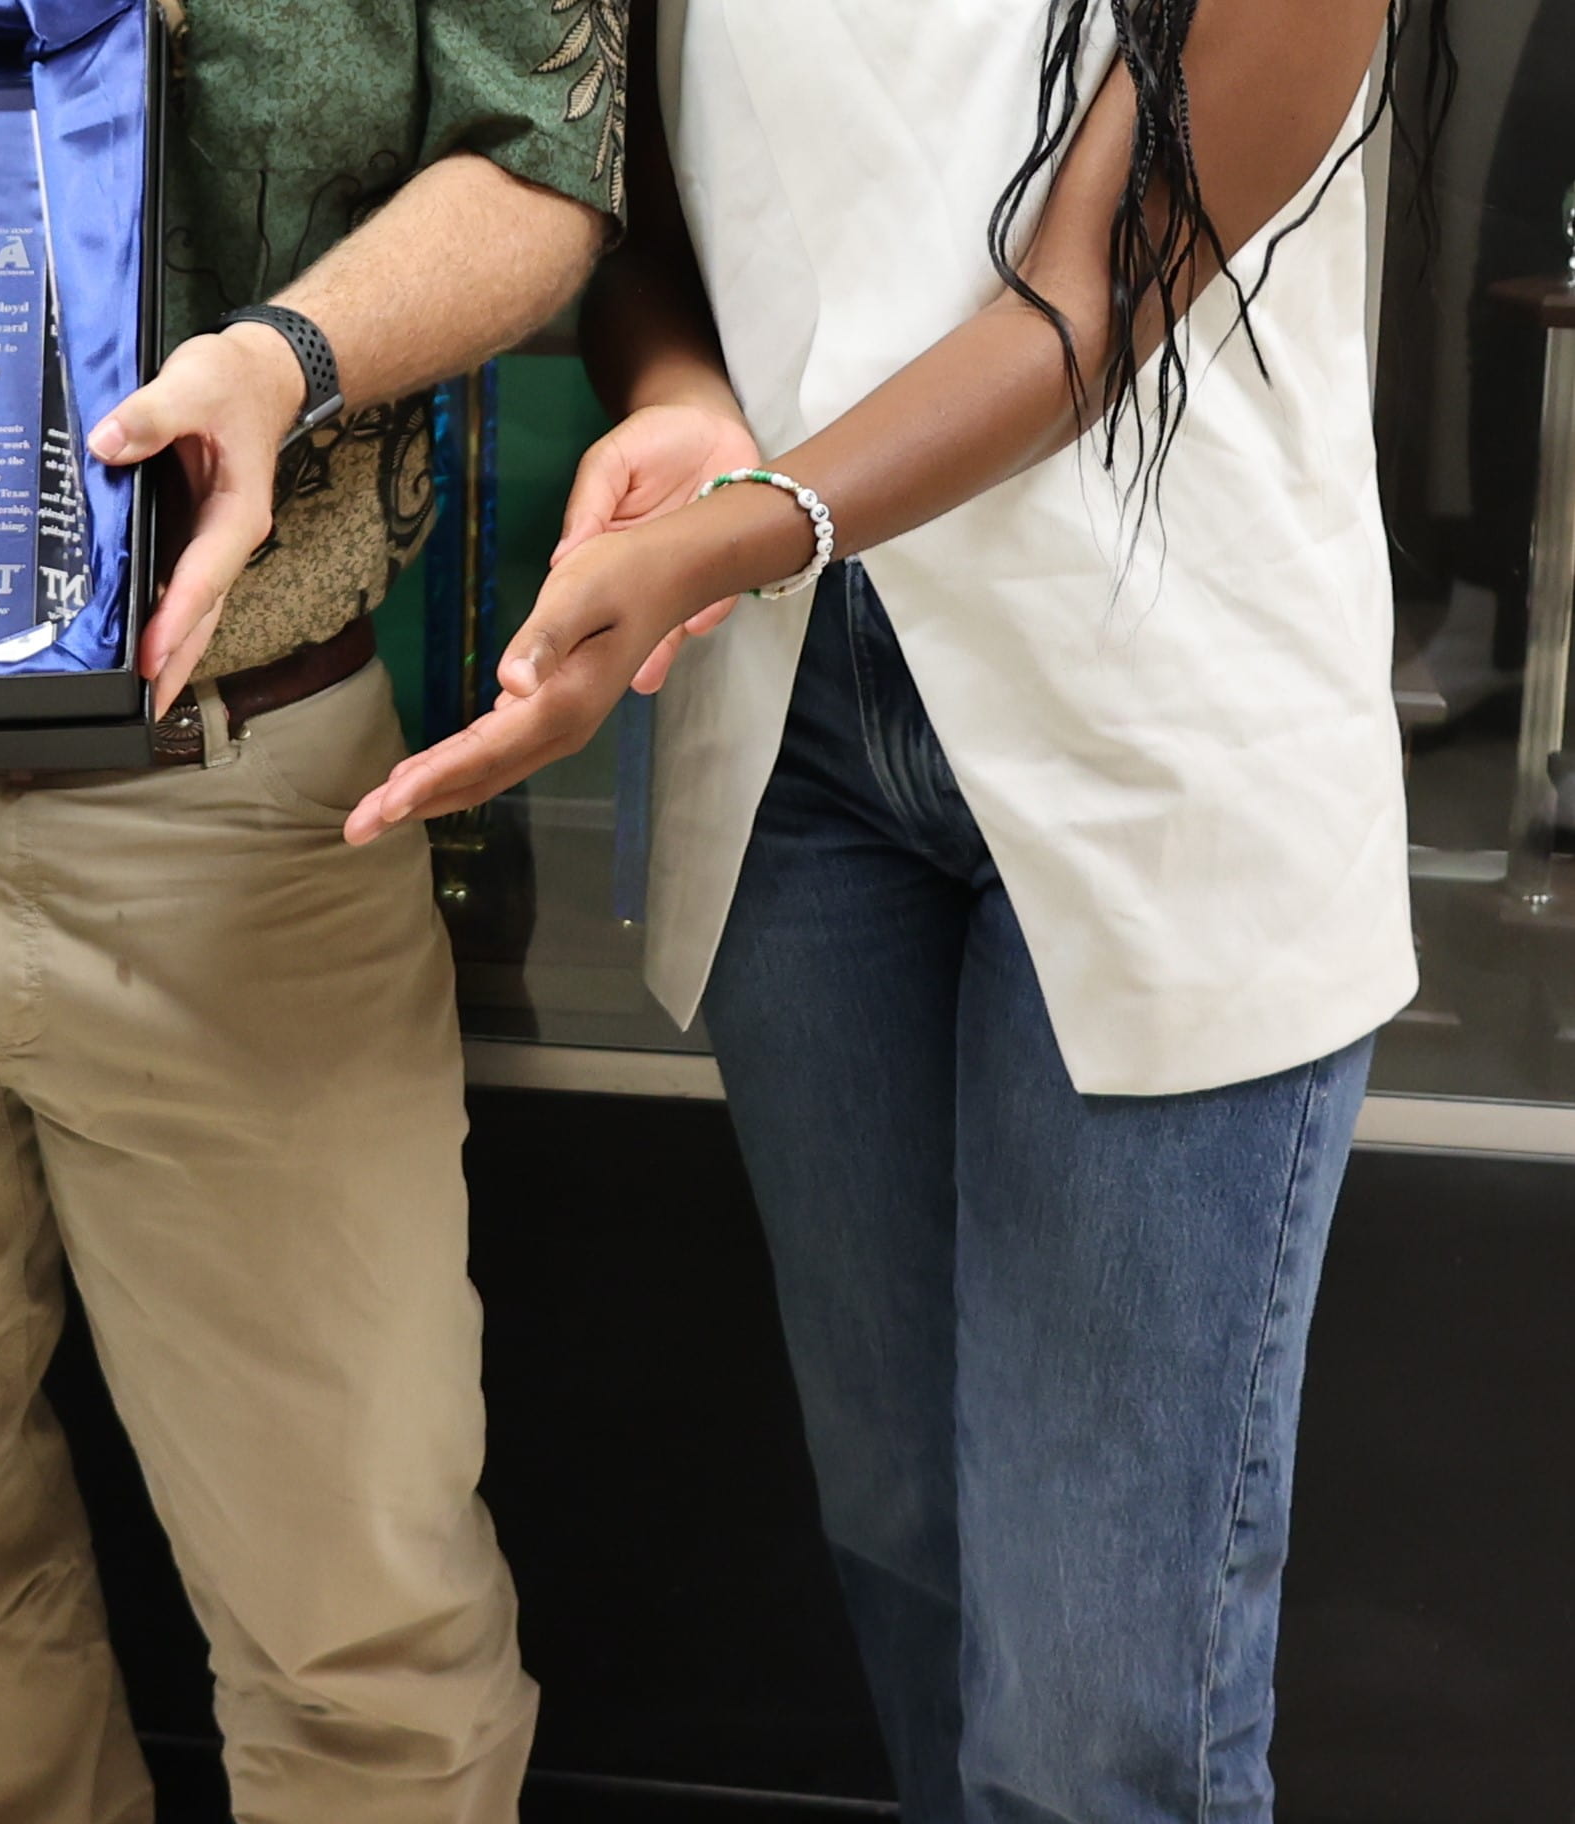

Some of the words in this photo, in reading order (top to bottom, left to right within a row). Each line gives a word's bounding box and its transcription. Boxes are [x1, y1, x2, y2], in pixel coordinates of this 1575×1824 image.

[4, 344, 18, 353] to
[3, 440, 31, 450] work
[8, 456, 26, 466] the
[0, 488, 30, 498] Texas
